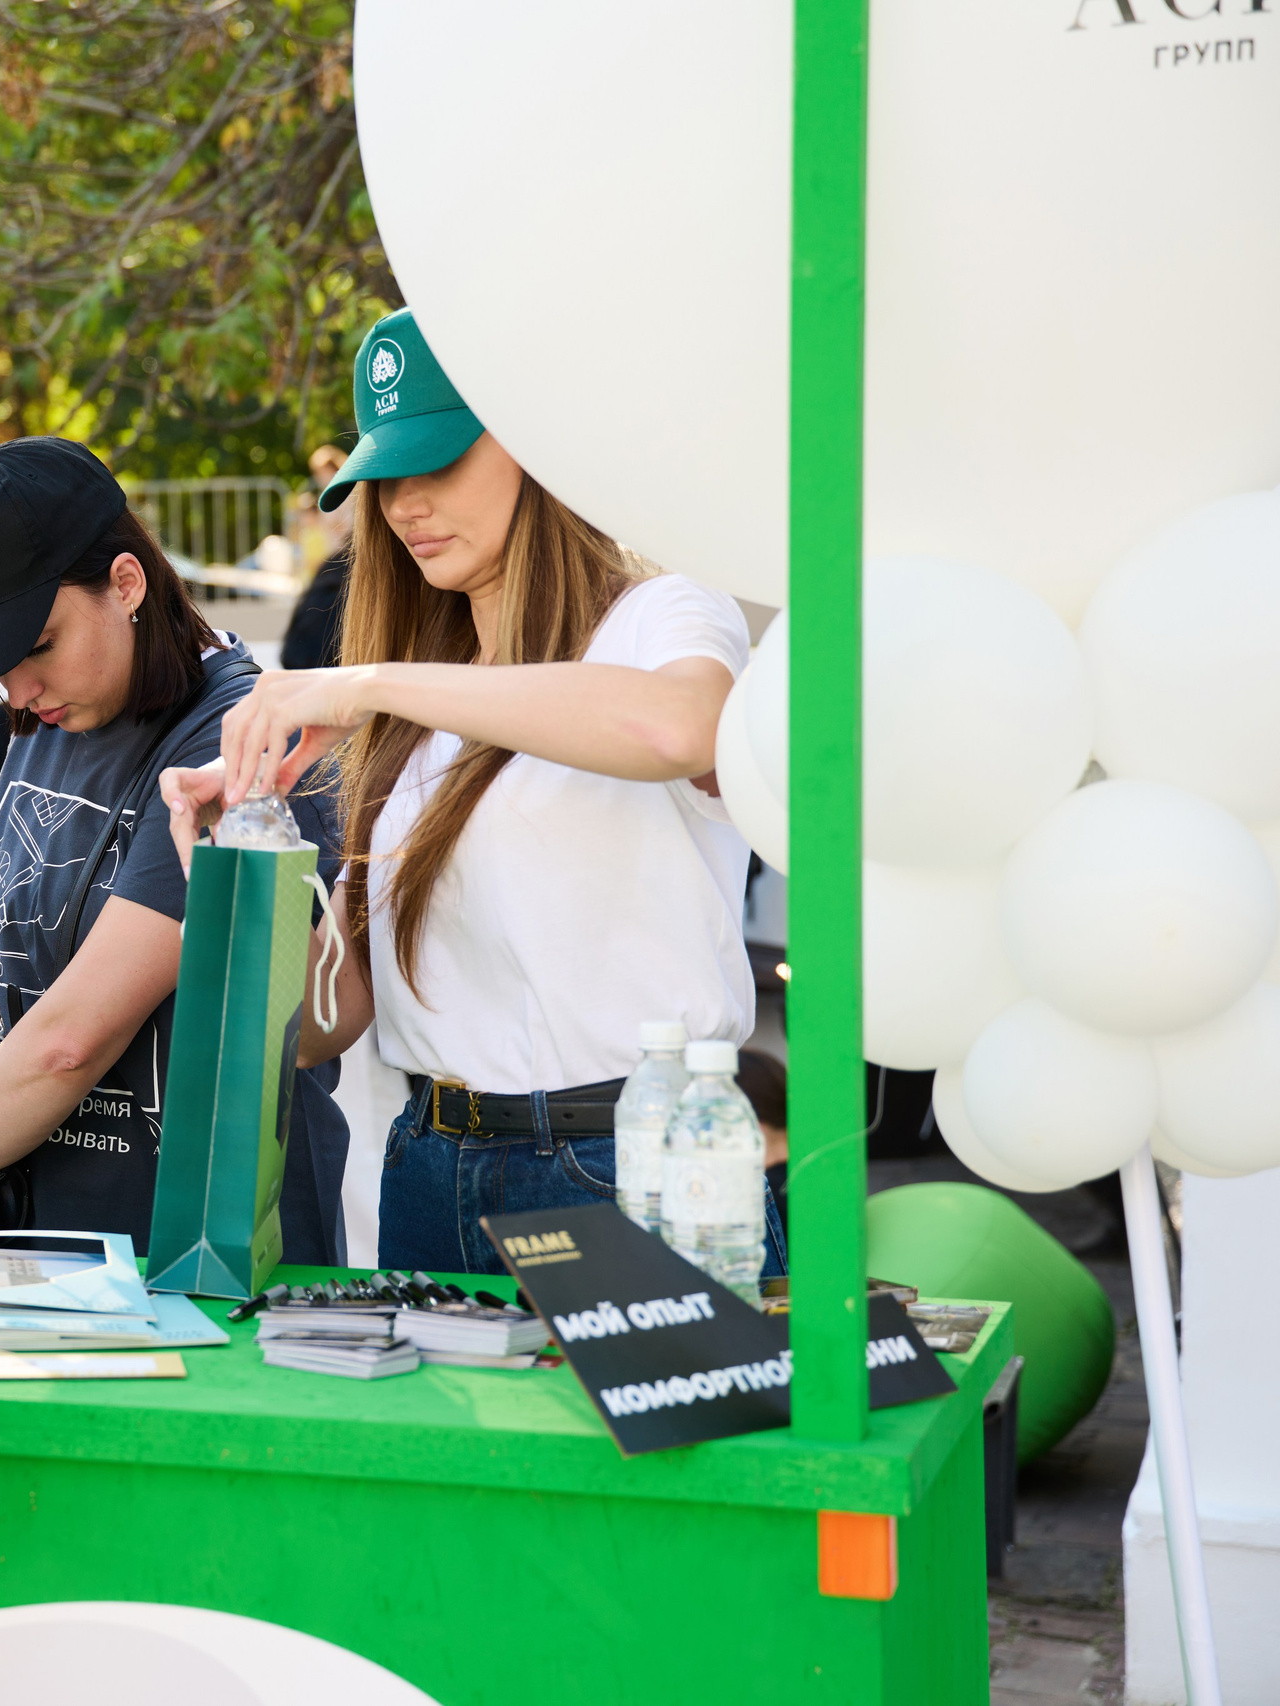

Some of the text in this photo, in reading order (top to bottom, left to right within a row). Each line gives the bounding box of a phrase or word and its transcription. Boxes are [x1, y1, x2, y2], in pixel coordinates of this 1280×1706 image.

[1153, 37, 1256, 69] ГРУПП
[375, 391, 399, 412] АСИ
[78, 1096, 131, 1118] ремя
[48, 1127, 131, 1154] рывать
[552, 1291, 716, 1343] МОЙ ОПЫТ
